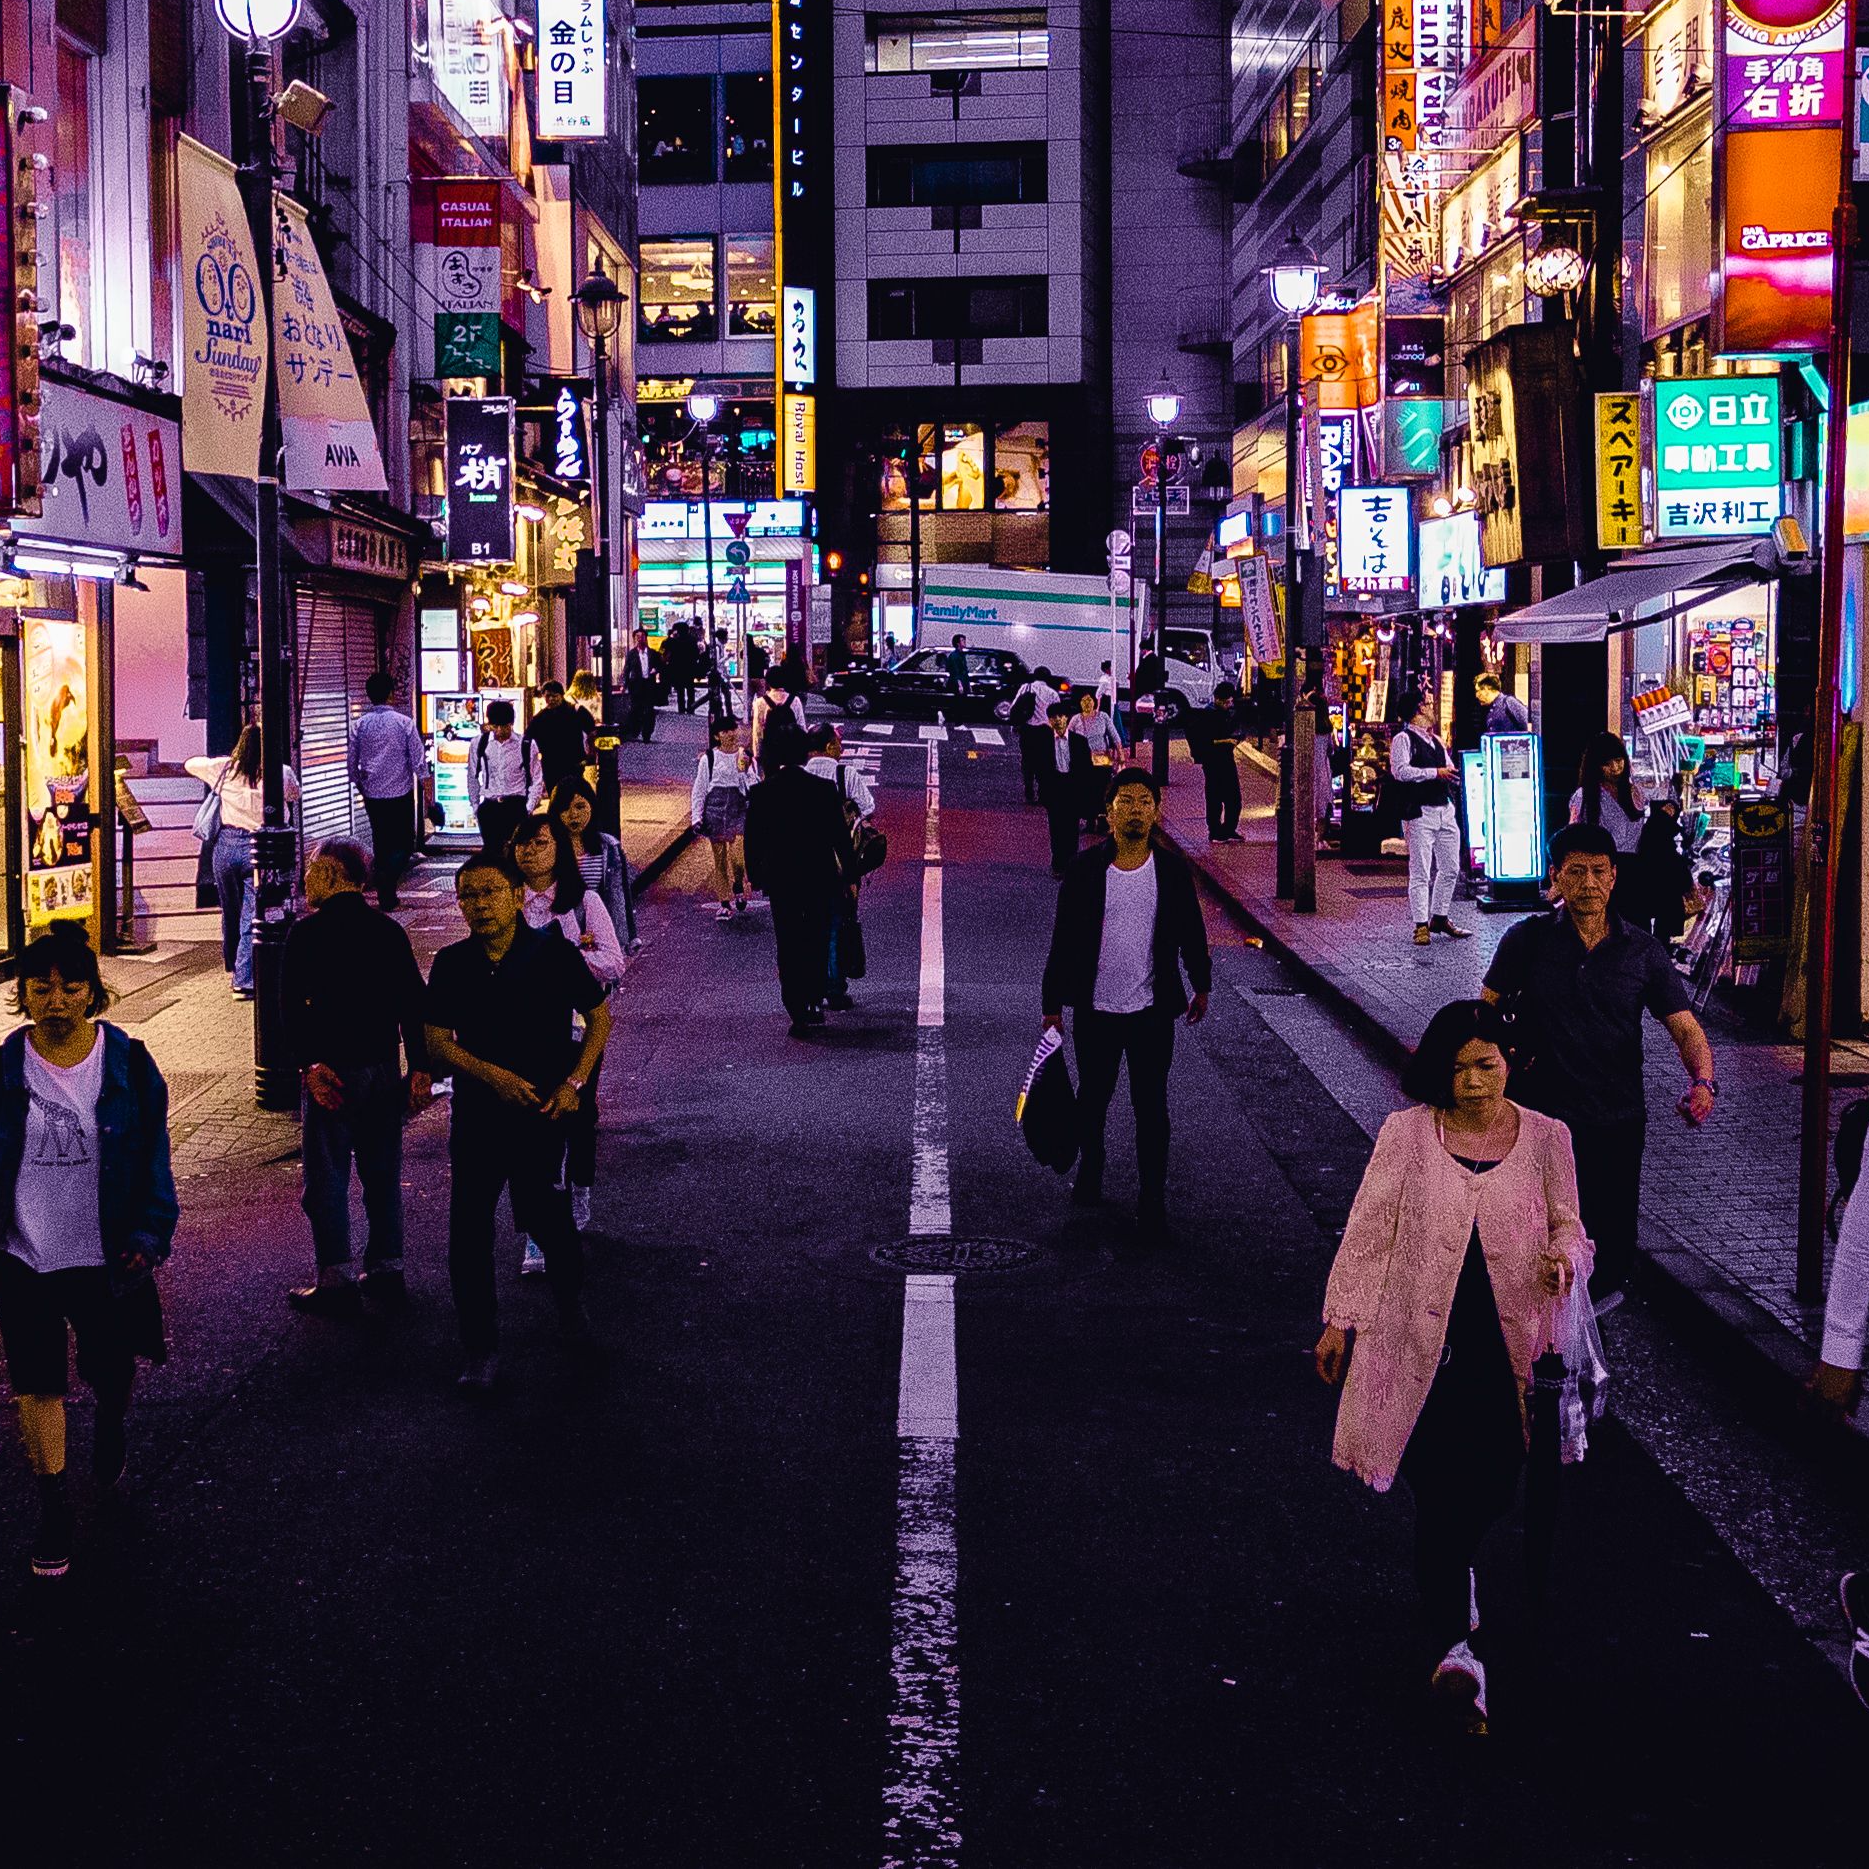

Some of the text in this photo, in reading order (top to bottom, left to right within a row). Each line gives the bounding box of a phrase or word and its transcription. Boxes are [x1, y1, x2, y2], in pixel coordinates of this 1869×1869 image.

[1387, 6, 1412, 62] 炭火
[549, 19, 576, 105] 金の目
[1744, 57, 1824, 83] 手前角
[1390, 79, 1414, 130] 焼肉
[1744, 83, 1824, 118] 右折
[441, 202, 492, 212] CASUAL
[441, 218, 492, 227] ITALIAN
[1741, 232, 1828, 249] CAPRICE
[195, 338, 262, 378] Sunday
[1708, 393, 1771, 426] 日立
[325, 443, 360, 468] AWA
[460, 444, 483, 456] パブ
[794, 402, 806, 485] Royal Host
[1609, 402, 1635, 543] スペアーキー
[1666, 500, 1772, 527] 吉沢利工
[471, 542, 491, 556] B1
[1362, 495, 1392, 574] 吉そば
